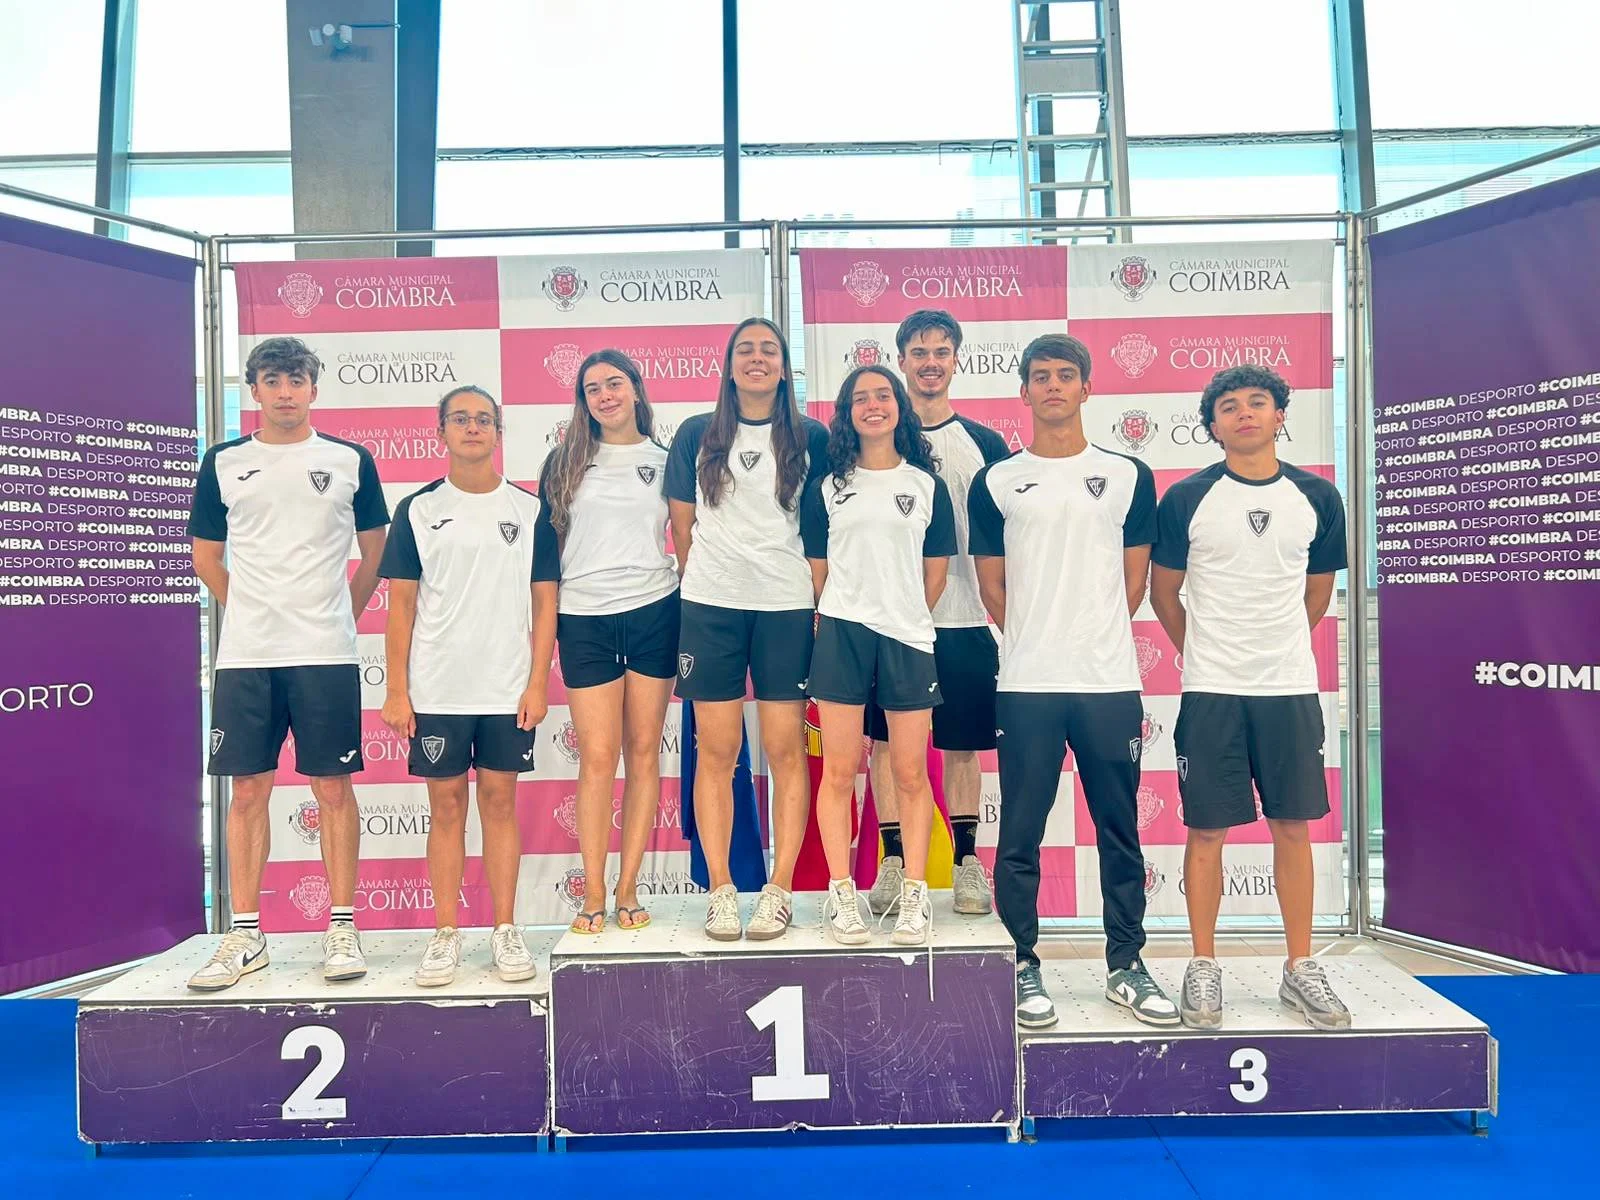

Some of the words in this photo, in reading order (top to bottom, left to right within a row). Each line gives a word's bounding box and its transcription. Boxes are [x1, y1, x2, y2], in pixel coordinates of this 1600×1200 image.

[902, 265, 953, 277] CÂMARA
[957, 265, 1022, 277] MUNICIPAL
[1169, 258, 1220, 270] CÂMARA
[1224, 258, 1290, 270] MUNICIPAL
[335, 276, 385, 287] CÂMARA
[389, 275, 455, 287] MUNICIPAL
[600, 269, 651, 281] CÂMARA
[655, 268, 720, 281] MUNICIPAL
[1169, 270, 1291, 292] COIMBRA
[600, 280, 722, 302] COIMBRA
[902, 277, 1023, 299] COIMBRA
[335, 286, 456, 309] COIMBRA
[959, 342, 1020, 353] MUNICIPAL
[1169, 336, 1221, 347] CÂMARA
[1224, 335, 1290, 347] MUNICIPAL
[337, 352, 387, 363] CÂMARA
[391, 352, 455, 363] MUNICIPAL
[620, 347, 653, 357] MARA
[657, 346, 720, 358] MUNICIPAL
[1169, 346, 1292, 369] COIMBRA
[631, 358, 722, 379] IMBRA
[953, 354, 1020, 375] MBRA
[338, 363, 457, 385] COIMBRA
[1384, 397, 1455, 416] #COIMBRA
[1460, 384, 1535, 405] DESPORTO
[47, 413, 123, 431] DESPORTO
[1170, 412, 1201, 424] CÂM
[1413, 411, 1483, 429] DESPORTO
[1487, 398, 1568, 419] #COIMBRA
[980, 418, 1024, 429] ICIPAL
[1418, 427, 1493, 446] #COIMBRA
[1498, 416, 1576, 436] DESPORTO
[2, 427, 71, 443] ESPORTO
[76, 434, 153, 451] #COIMBRA
[340, 427, 389, 439] CÂMARA
[393, 427, 438, 439] MUNICI
[360, 438, 449, 459] OIMBR
[1385, 450, 1456, 466] #COIMBRA
[1461, 440, 1536, 458] DESPORTO
[87, 453, 160, 468] DESPORTO
[1391, 467, 1458, 483] DESPORTO
[1462, 458, 1542, 476] #COIMBRA
[1546, 452, 1598, 467] DESPO
[48, 467, 124, 482] DESPORTO
[0, 483, 45, 495] ORTO
[49, 486, 129, 500] #COIMBRA
[133, 491, 192, 504] DESPORT
[1386, 484, 1457, 499] #COIMBRA
[1461, 477, 1538, 493] DESPORTO
[48, 503, 125, 517] DESPORTO
[128, 508, 190, 520] #COIMBR
[1414, 500, 1485, 514] DESPORTO
[1488, 493, 1571, 509] #COIMBRA
[0, 520, 73, 532] ESPORTO
[77, 523, 154, 535] #COIMBRA
[1386, 520, 1458, 533] #COIMBRA
[1462, 514, 1539, 529] DESPORTO
[49, 540, 125, 551] DESPORTO
[128, 542, 193, 553] #COIMBR
[1415, 536, 1485, 549] DESPORTO
[1489, 531, 1572, 545] #COIMBRA
[0, 557, 74, 568] ESPORTO
[78, 558, 155, 569] #COIMBRA
[159, 560, 192, 569] DESP
[1420, 554, 1496, 565] #COIMBRA
[1500, 550, 1580, 563] DESPORTO
[0, 576, 85, 586] #COIMBRA
[89, 576, 162, 586] DESPORTO
[1387, 573, 1459, 583] #COIMBRA
[1463, 570, 1539, 582] DESPORTO
[1544, 569, 1600, 580] #COIM
[50, 594, 126, 604] DESPORTO
[129, 593, 201, 605] #COIMBRA
[0, 683, 94, 712] ORTO
[363, 730, 395, 740] MARA
[359, 803, 397, 815] MARA
[360, 815, 431, 835] OIMB
[1233, 864, 1272, 876] MUNIC
[357, 878, 400, 889] ÂMARA
[353, 888, 470, 911] COIMBA
[745, 985, 830, 1101] 1
[281, 1025, 347, 1120] 2
[1229, 1048, 1268, 1103] 3
